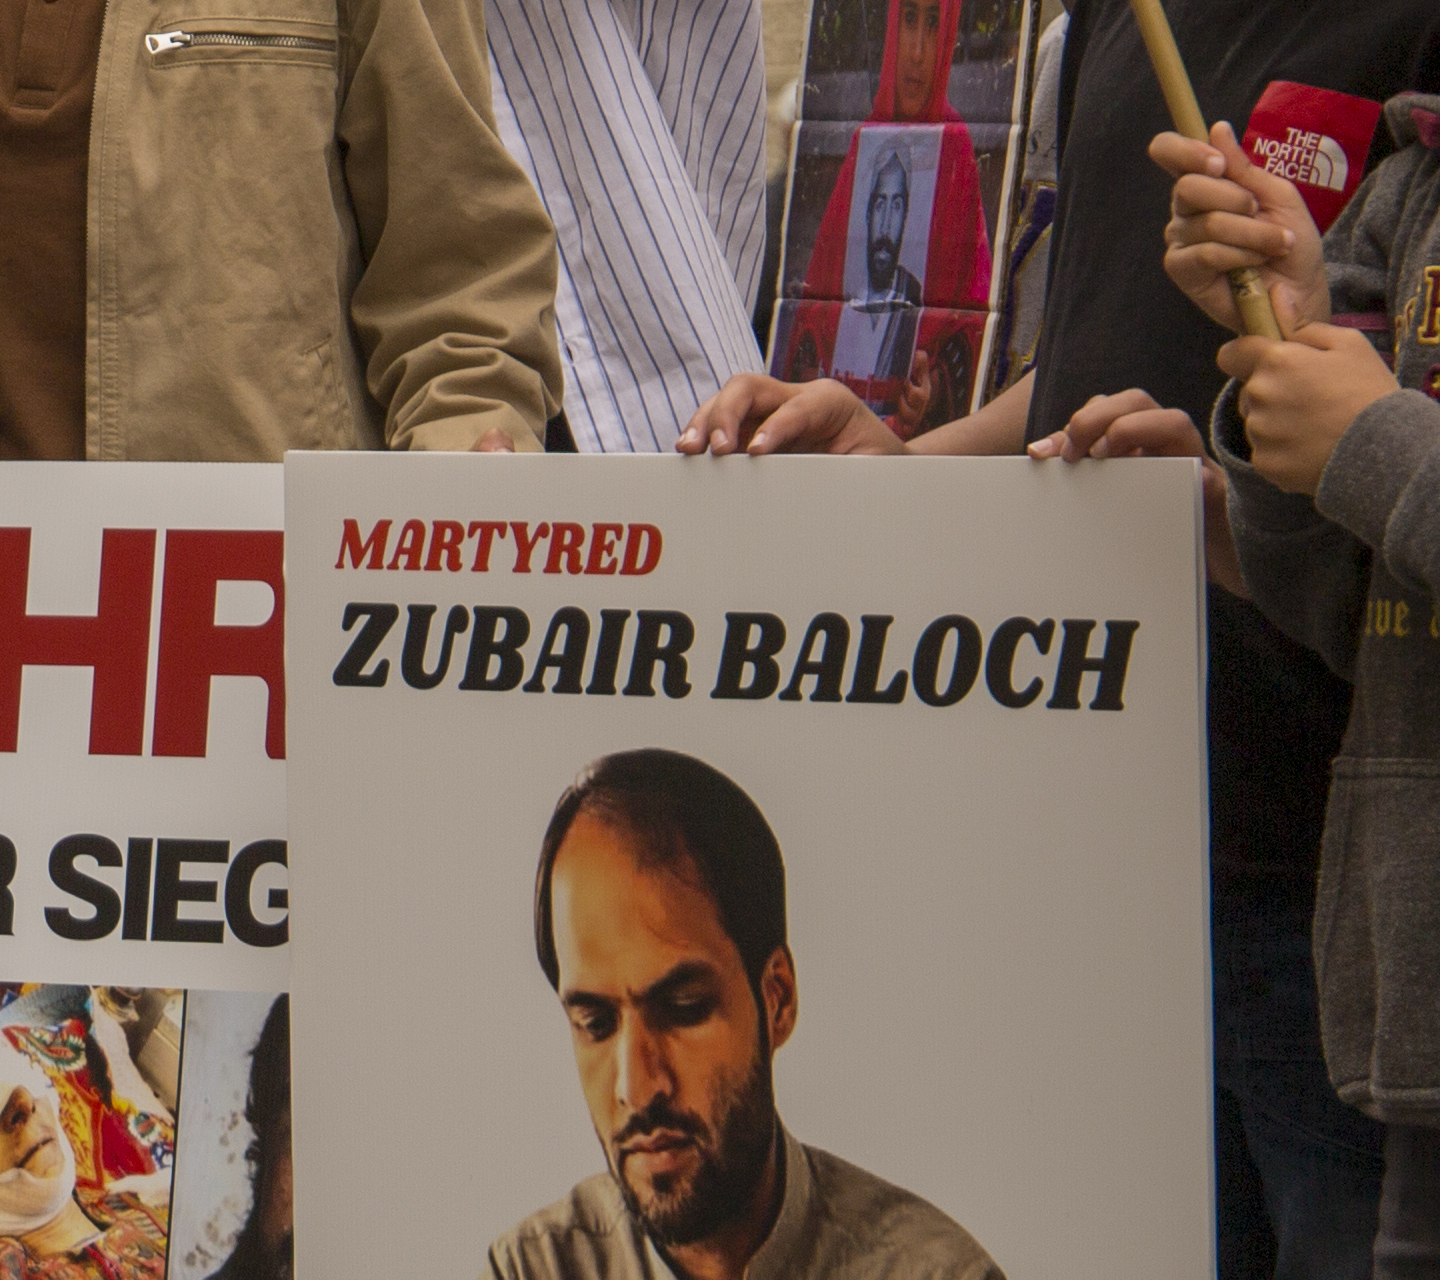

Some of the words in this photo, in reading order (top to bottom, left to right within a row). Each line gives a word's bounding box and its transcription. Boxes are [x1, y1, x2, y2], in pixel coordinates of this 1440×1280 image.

[1254, 138, 1315, 165] NORTH
[1286, 127, 1320, 149] THE
[1264, 157, 1310, 182] FACE
[334, 518, 664, 578] MARTYRED
[331, 602, 697, 701] ZUBAIR
[711, 611, 1141, 713] BALOCH
